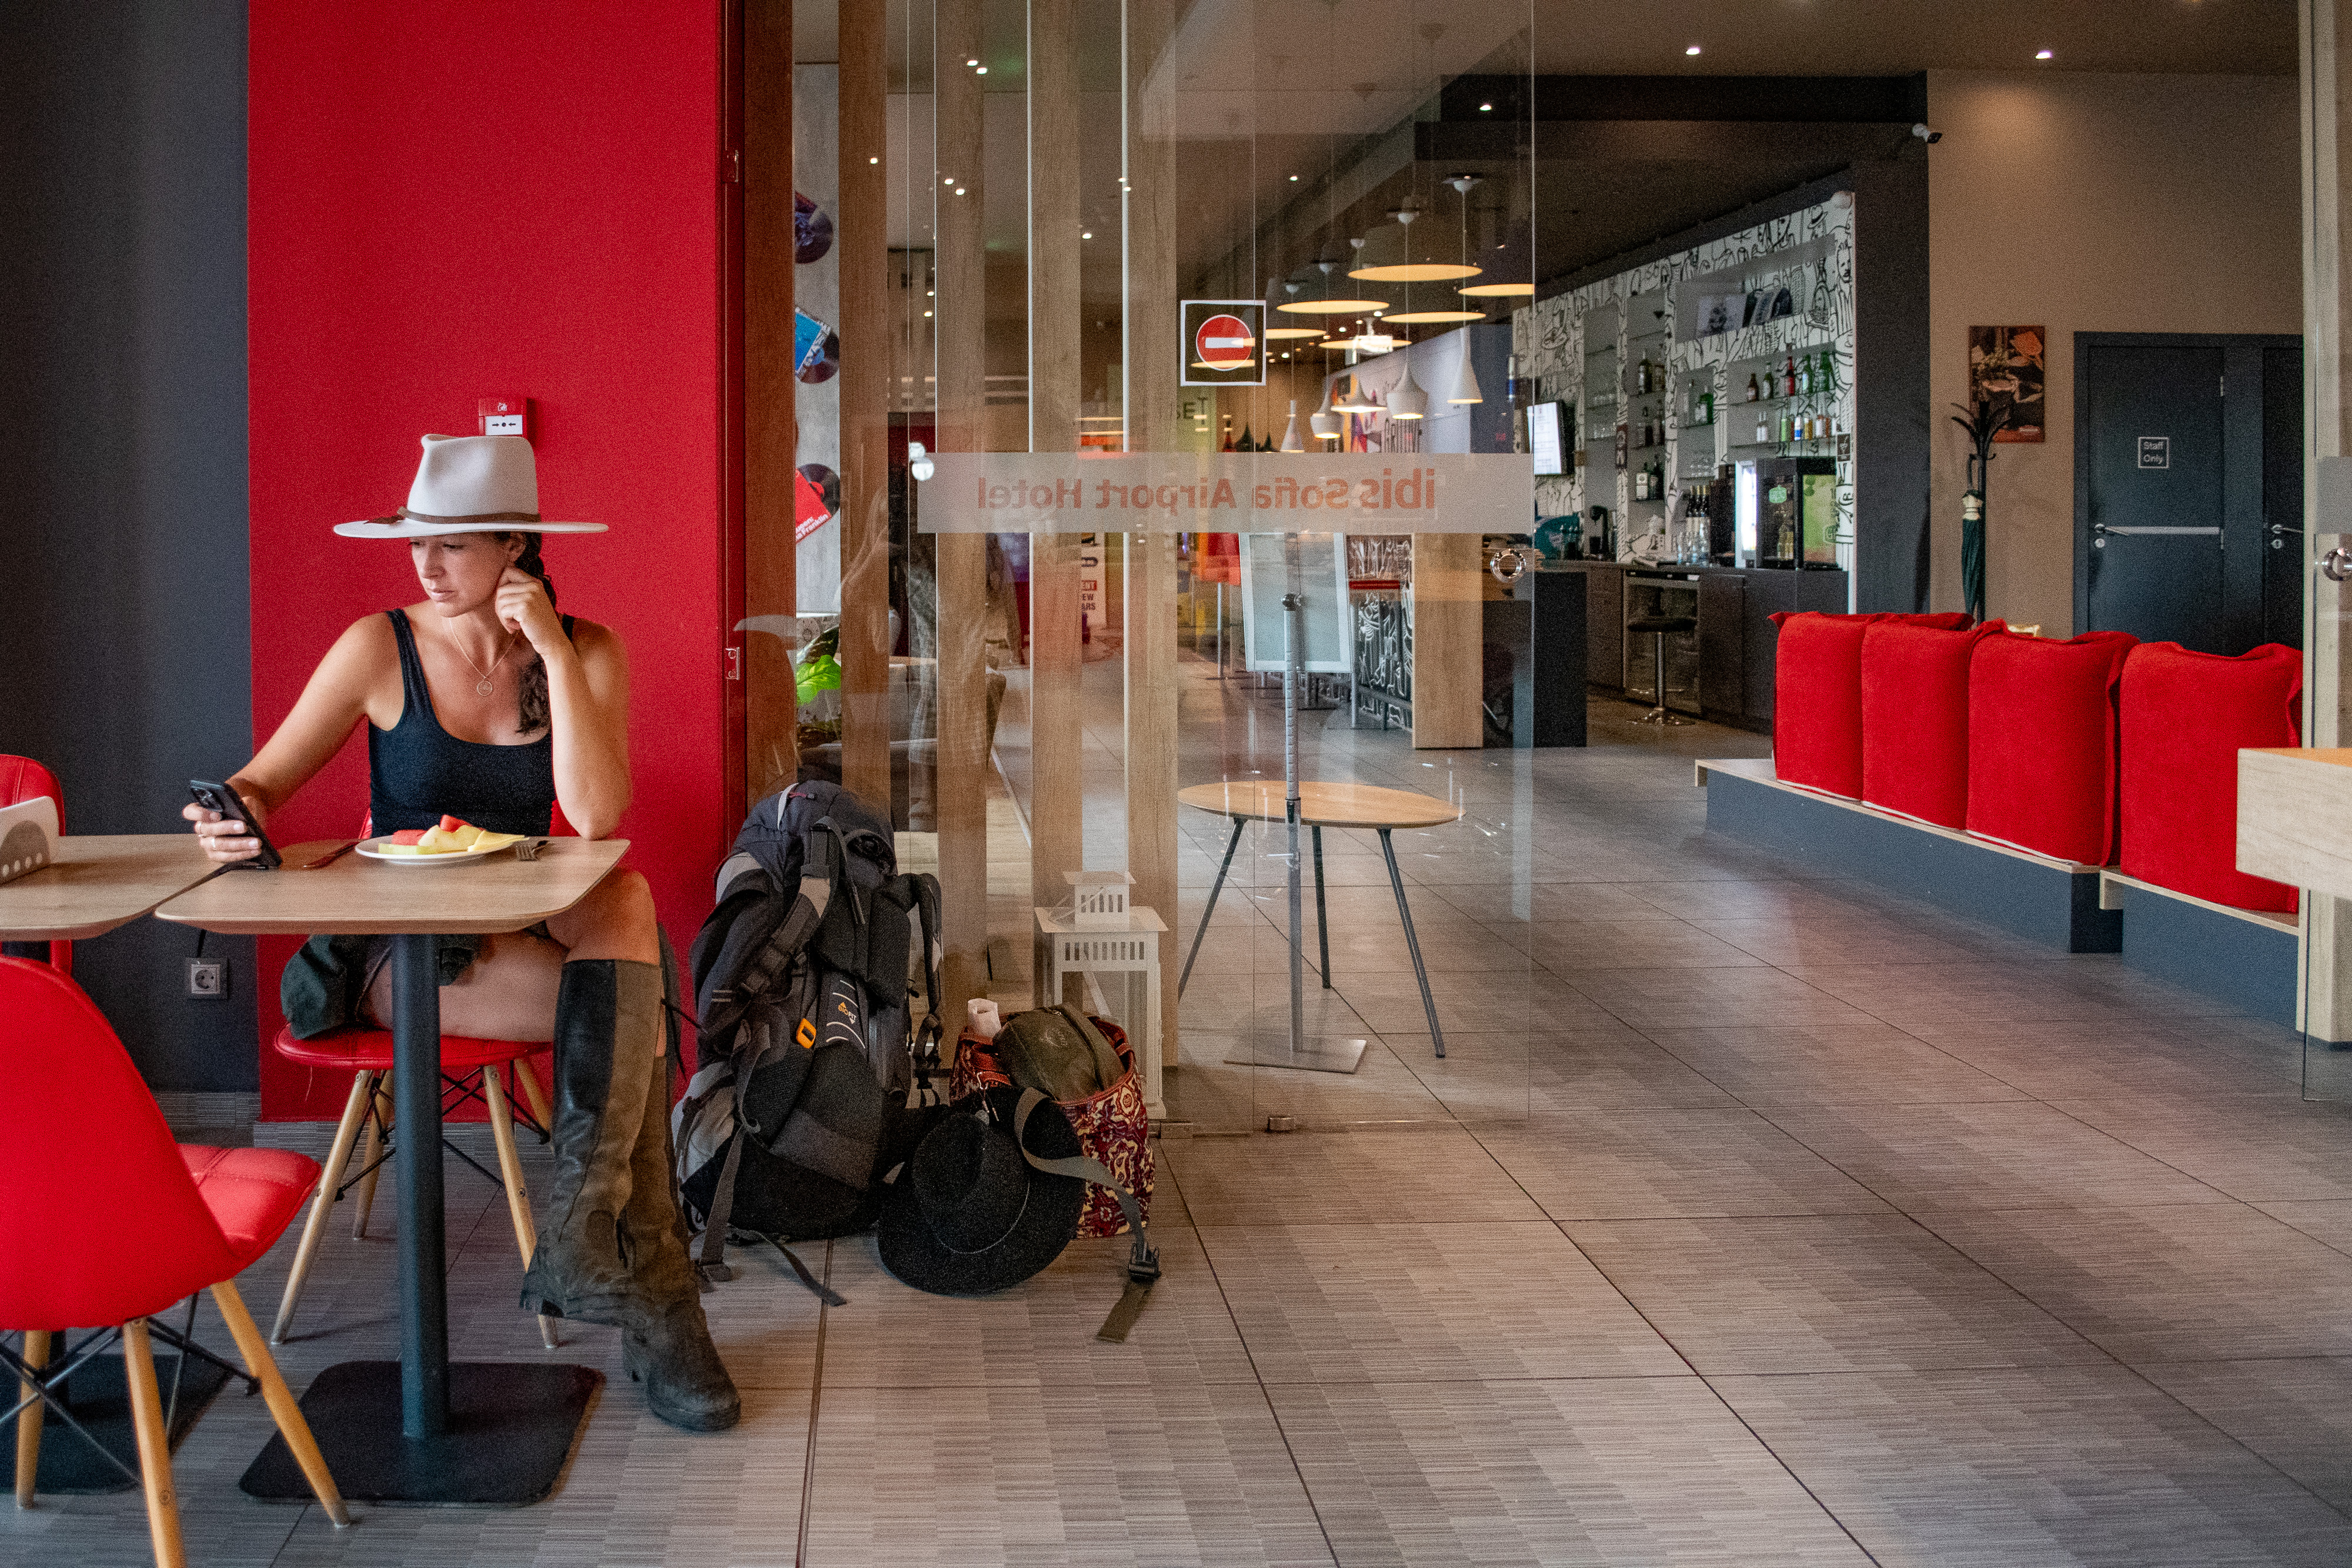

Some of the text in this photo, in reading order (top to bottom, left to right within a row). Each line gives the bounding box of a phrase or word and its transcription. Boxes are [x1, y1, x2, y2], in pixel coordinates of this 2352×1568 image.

[2143, 441, 2164, 450] Staff
[2143, 454, 2163, 464] Only
[838, 1005, 857, 1021] BIOFIT
